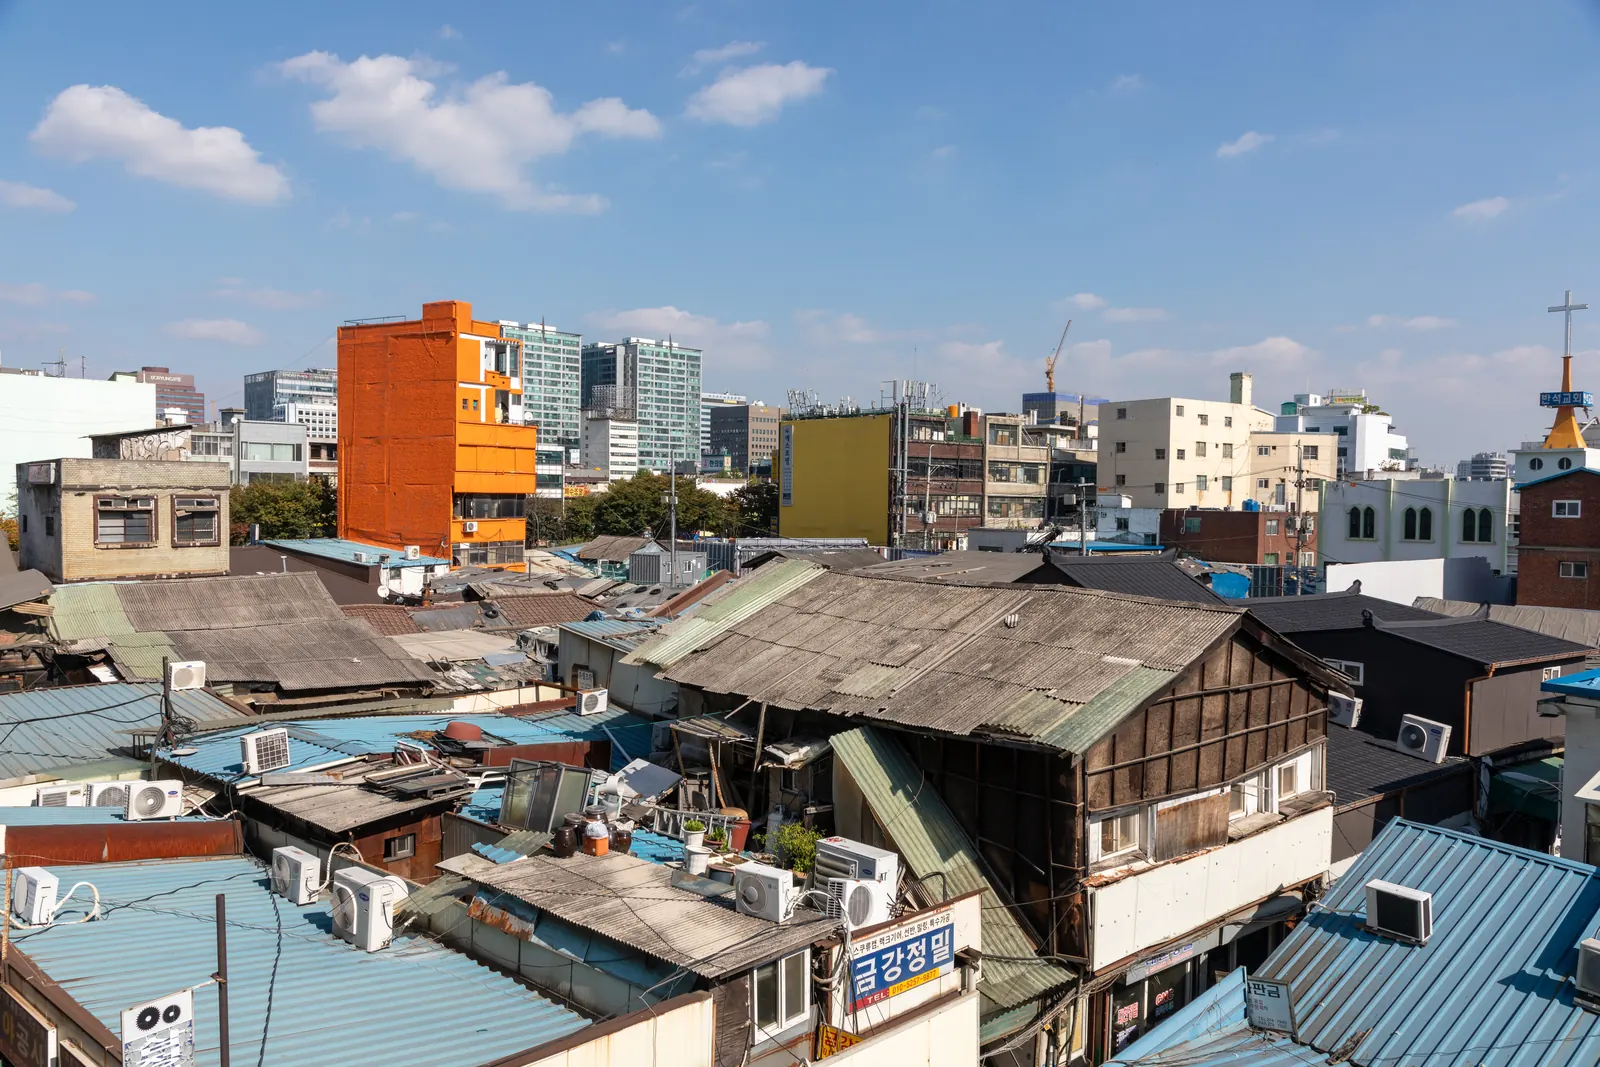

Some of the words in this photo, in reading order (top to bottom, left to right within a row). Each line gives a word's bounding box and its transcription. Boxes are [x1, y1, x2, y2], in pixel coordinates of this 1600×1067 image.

[1541, 393, 1582, 404] 반석교회
[854, 929, 950, 995] 금강정밀
[867, 990, 889, 1004] TEL:
